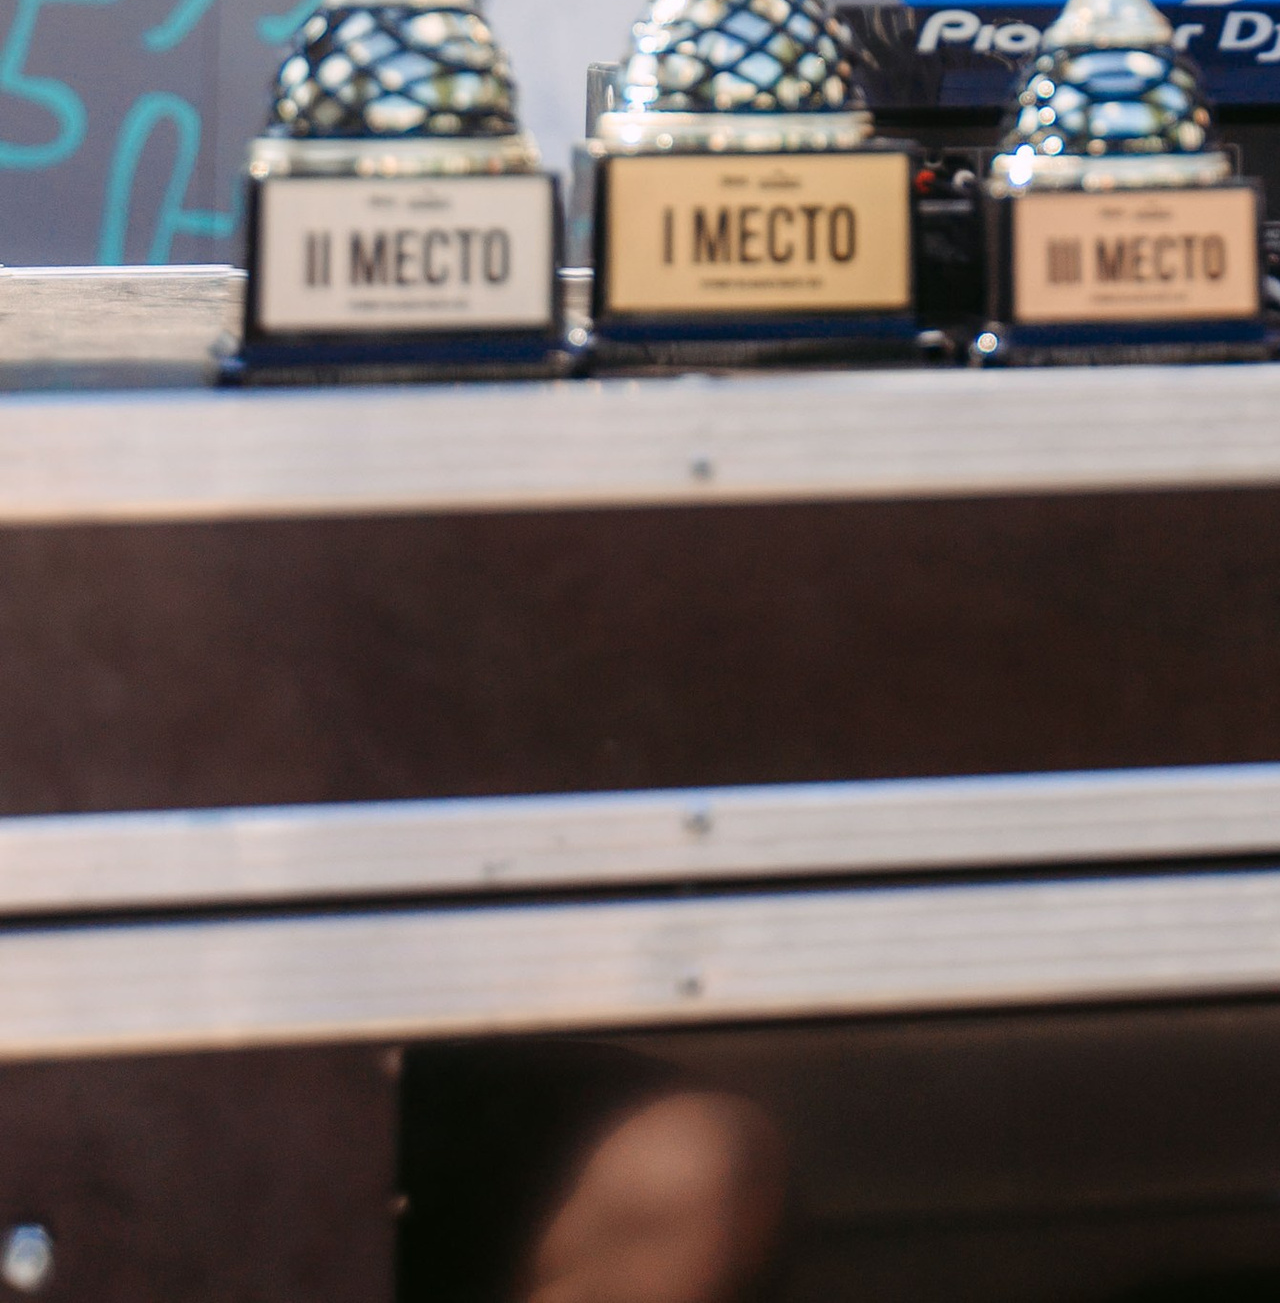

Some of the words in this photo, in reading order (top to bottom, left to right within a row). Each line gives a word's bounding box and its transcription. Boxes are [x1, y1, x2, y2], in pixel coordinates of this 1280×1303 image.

[918, 9, 1204, 53] Pior
[351, 227, 512, 287] МЕСТО
[694, 203, 857, 265] МЕСТО
[1096, 233, 1227, 283] МЕСТО
